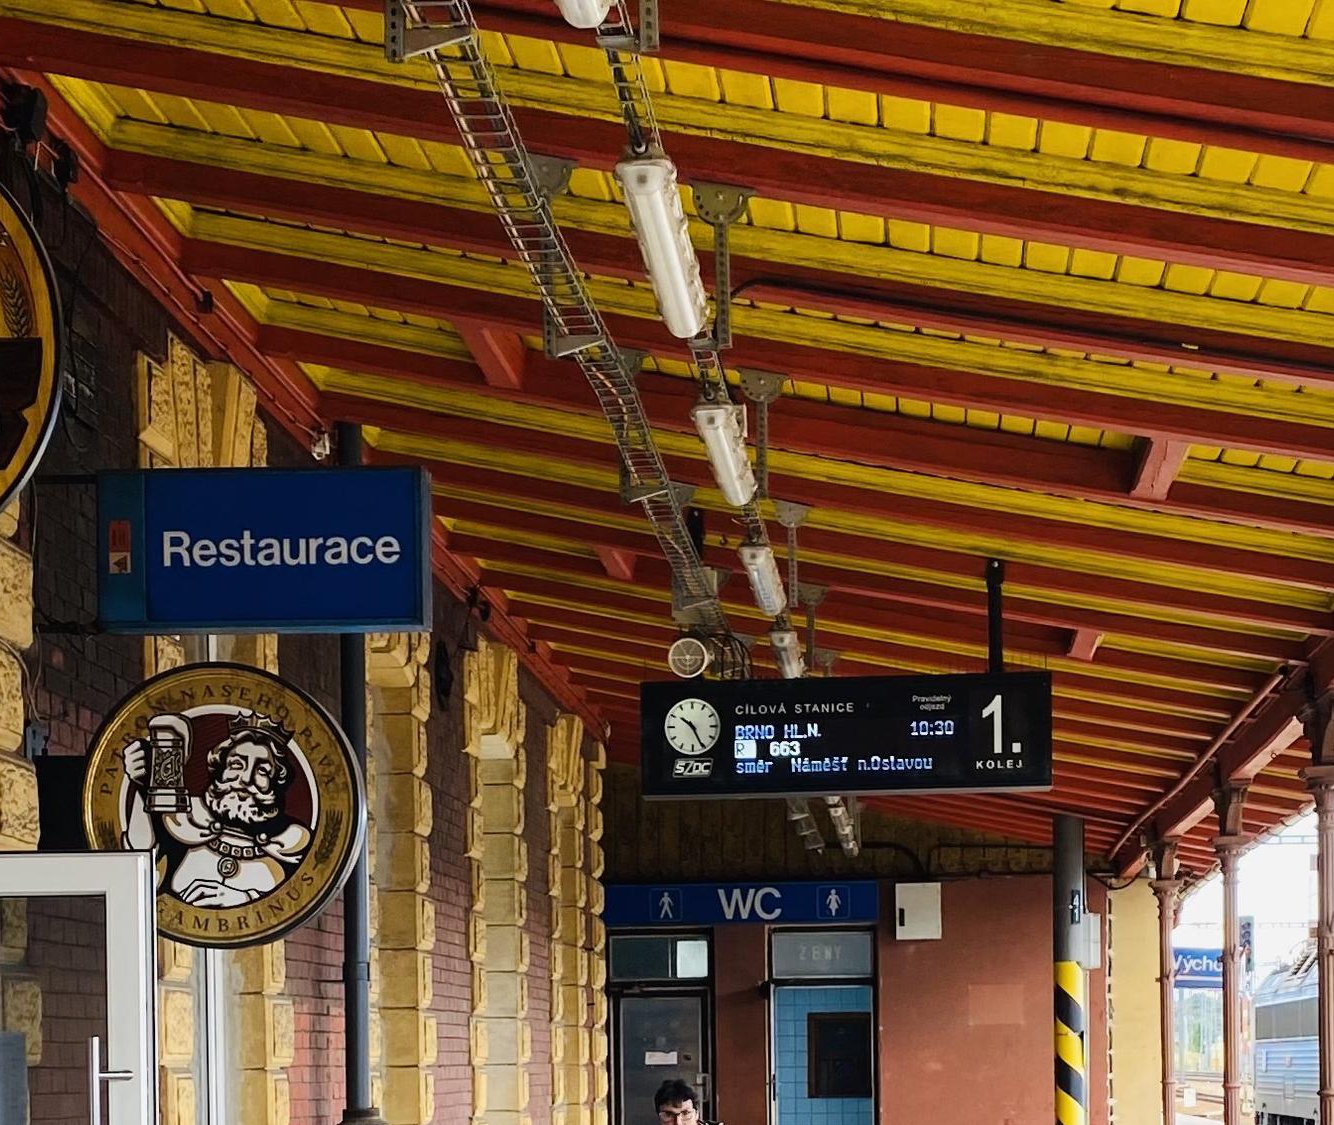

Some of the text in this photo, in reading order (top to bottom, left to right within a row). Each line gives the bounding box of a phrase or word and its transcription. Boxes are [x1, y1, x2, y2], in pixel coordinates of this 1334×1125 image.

[162, 530, 402, 567] Restaurace
[735, 702, 855, 715] CÍLOVÁ STANICE
[734, 725, 775, 740] BRNO
[910, 720, 955, 735] 10:30
[736, 741, 800, 756] R 663
[736, 760, 774, 774] směr
[976, 759, 1024, 770] KOLEJ
[717, 887, 783, 921] WC
[1173, 954, 1223, 973] Výcho
